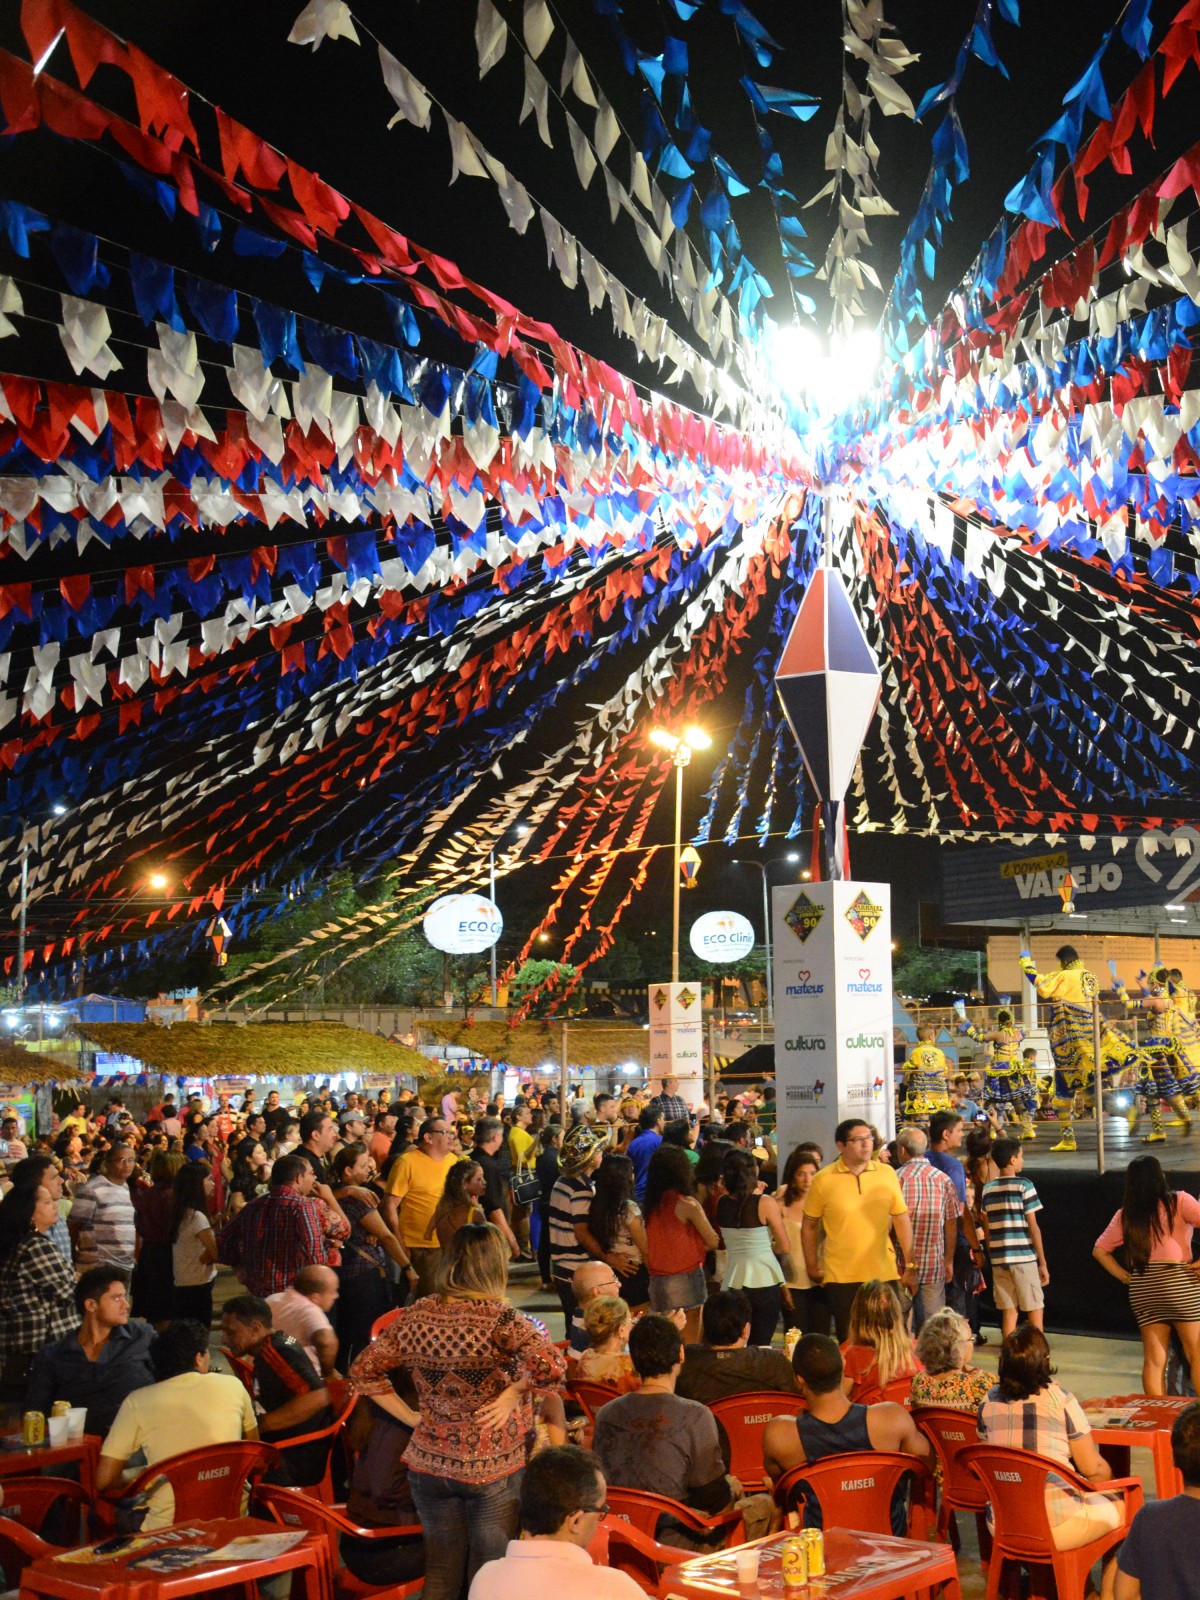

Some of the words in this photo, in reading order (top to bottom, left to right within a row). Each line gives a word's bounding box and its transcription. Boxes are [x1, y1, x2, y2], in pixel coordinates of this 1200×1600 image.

[459, 921, 488, 932] ECO
[803, 917, 817, 928] 90
[863, 916, 877, 927] 90
[703, 934, 727, 945] ECO
[785, 982, 824, 996] mateus
[846, 980, 883, 993] mateus
[784, 1035, 826, 1052] cultura
[845, 1033, 885, 1049] cultura
[942, 1430, 965, 1441] KAISER
[198, 1466, 230, 1481] KAISER
[994, 1470, 1022, 1482] KAISER
[841, 1477, 875, 1491] KAISER
